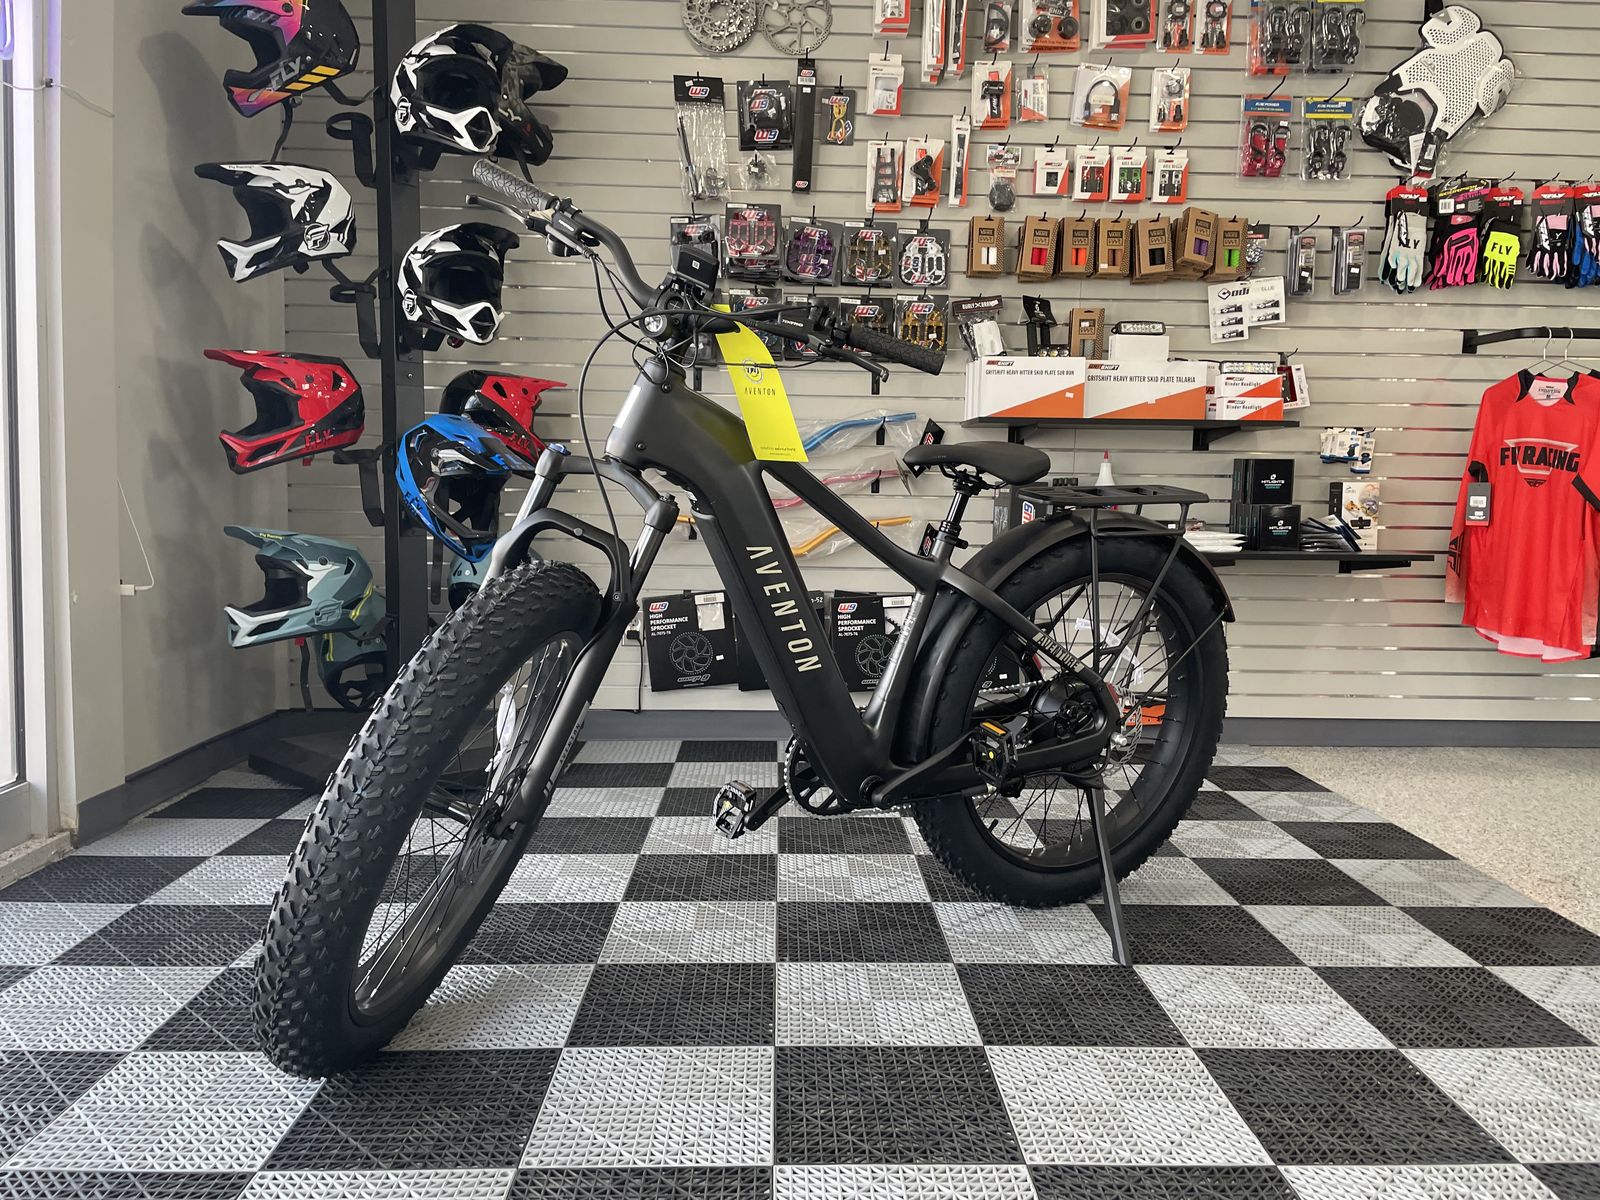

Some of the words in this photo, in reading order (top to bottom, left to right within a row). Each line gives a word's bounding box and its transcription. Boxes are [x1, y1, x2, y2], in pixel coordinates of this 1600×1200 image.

[690, 86, 710, 97] W9
[755, 129, 779, 142] W9
[1491, 242, 1513, 255] FLY
[744, 387, 776, 396] AVENTON
[649, 602, 669, 612] W9
[746, 546, 822, 672] AVENTON
[837, 602, 858, 613] W9
[650, 617, 689, 625] PERFORMANCE
[650, 624, 677, 632] SPROCKET
